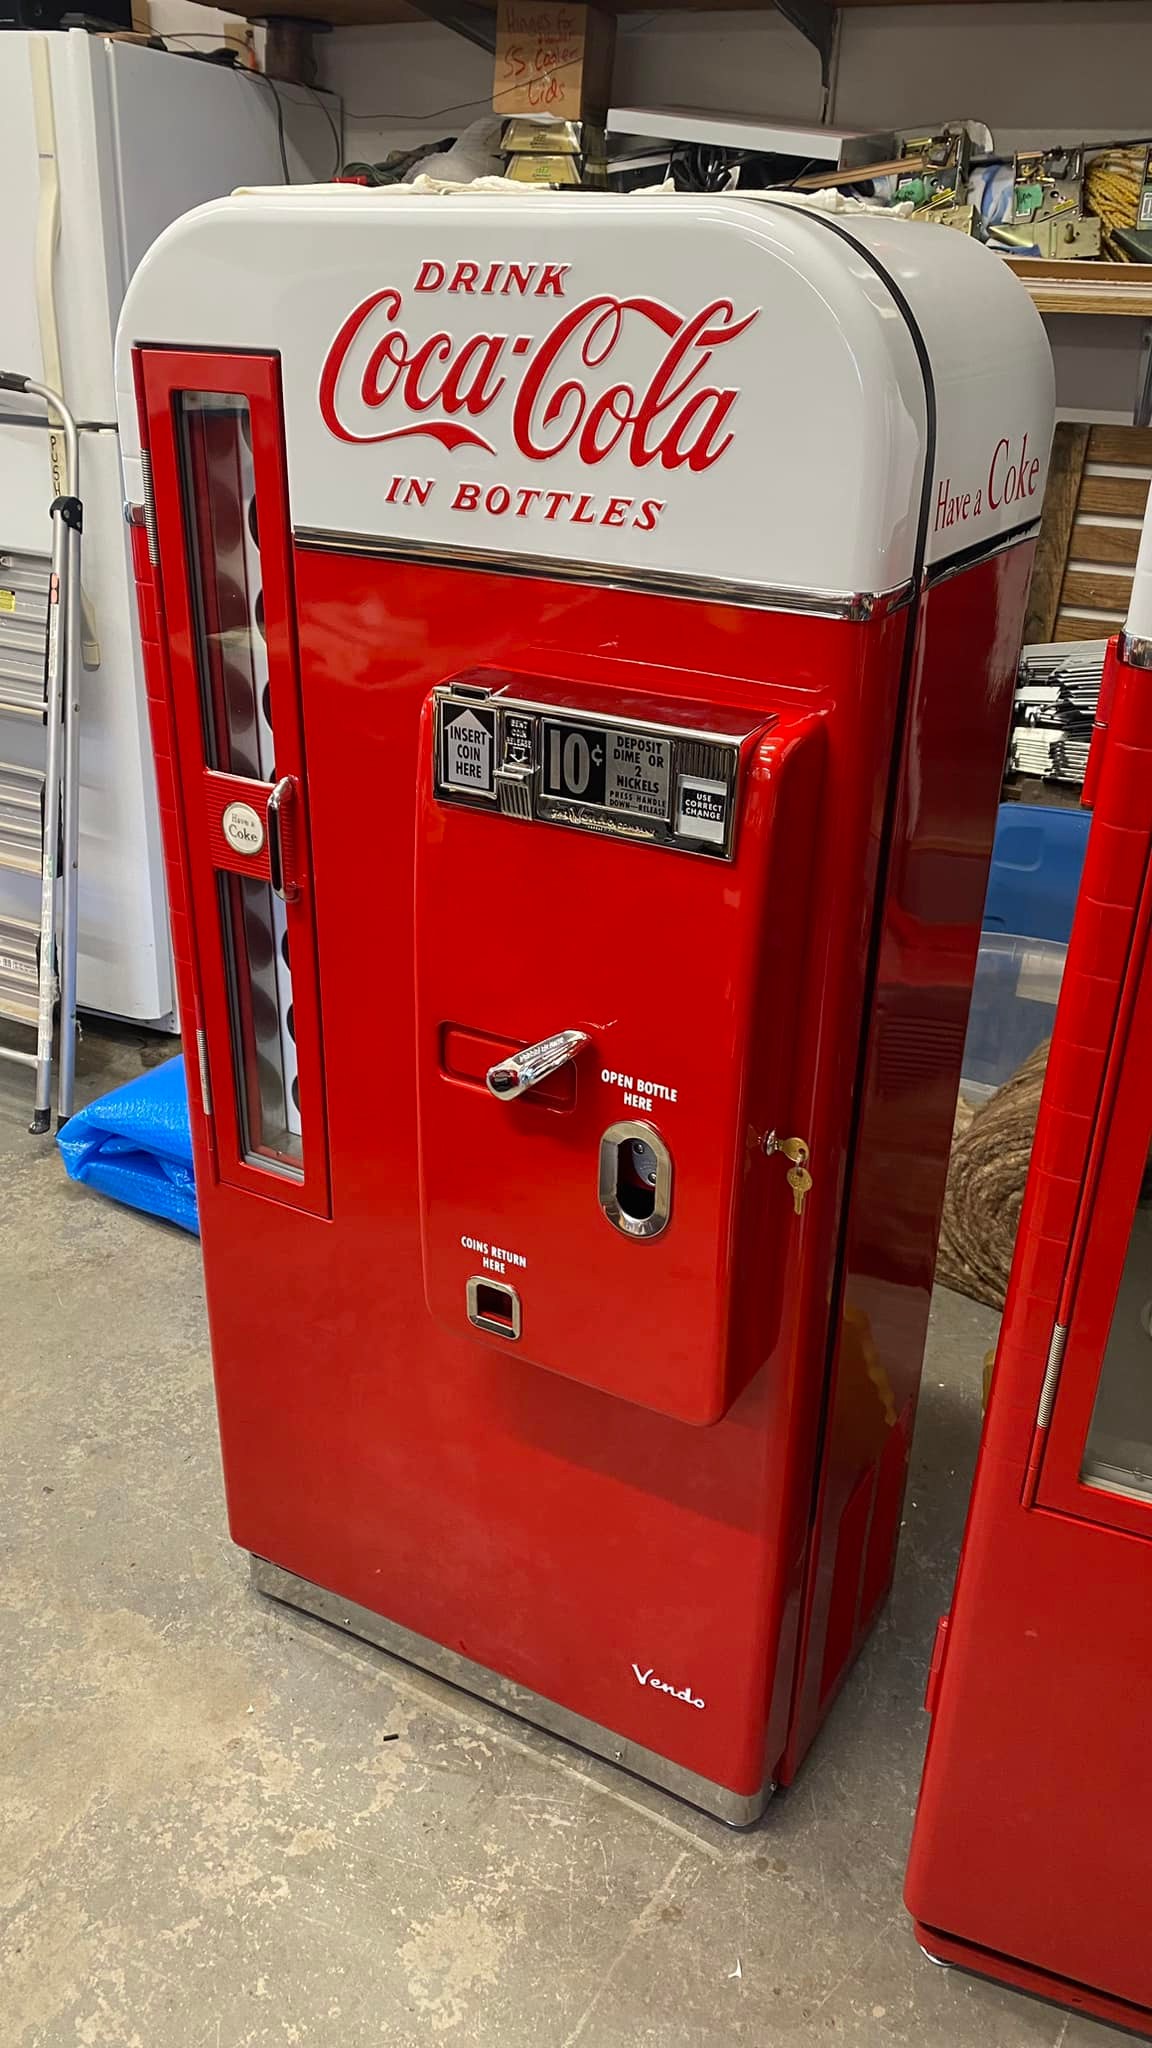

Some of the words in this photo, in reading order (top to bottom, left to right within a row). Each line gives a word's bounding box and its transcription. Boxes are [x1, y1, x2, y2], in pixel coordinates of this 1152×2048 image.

[528, 77, 565, 106] Lids
[414, 261, 570, 296] DRINK
[318, 288, 763, 473] Coca-Cola
[50, 434, 61, 497] PUSH
[934, 478, 971, 532] Have
[973, 488, 982, 516] a
[988, 432, 1040, 510] Coke
[384, 475, 434, 505] IN
[451, 483, 666, 532] BOTTLES
[450, 725, 487, 746] INSERT
[617, 736, 663, 755] DEPOSIT
[457, 744, 481, 762] COIN
[614, 748, 641, 764] DIME
[648, 755, 664, 769] OR
[456, 760, 483, 779] HERE
[634, 765, 642, 778] 2
[617, 775, 660, 793] NICKELS
[609, 790, 633, 801] PRESS
[636, 795, 665, 808] HANDLE
[685, 799, 722, 812] CORRECT
[696, 793, 712, 802] USE
[685, 807, 721, 820] CHANGE
[228, 823, 259, 841] Coke
[601, 1069, 633, 1090] OPEN
[637, 1078, 677, 1103] BOTTLE
[623, 1091, 653, 1112] HERE
[461, 1235, 489, 1254] COINS
[491, 1245, 527, 1268] RETURN
[482, 1256, 505, 1274] HERE
[631, 1663, 705, 1709] Vendo
